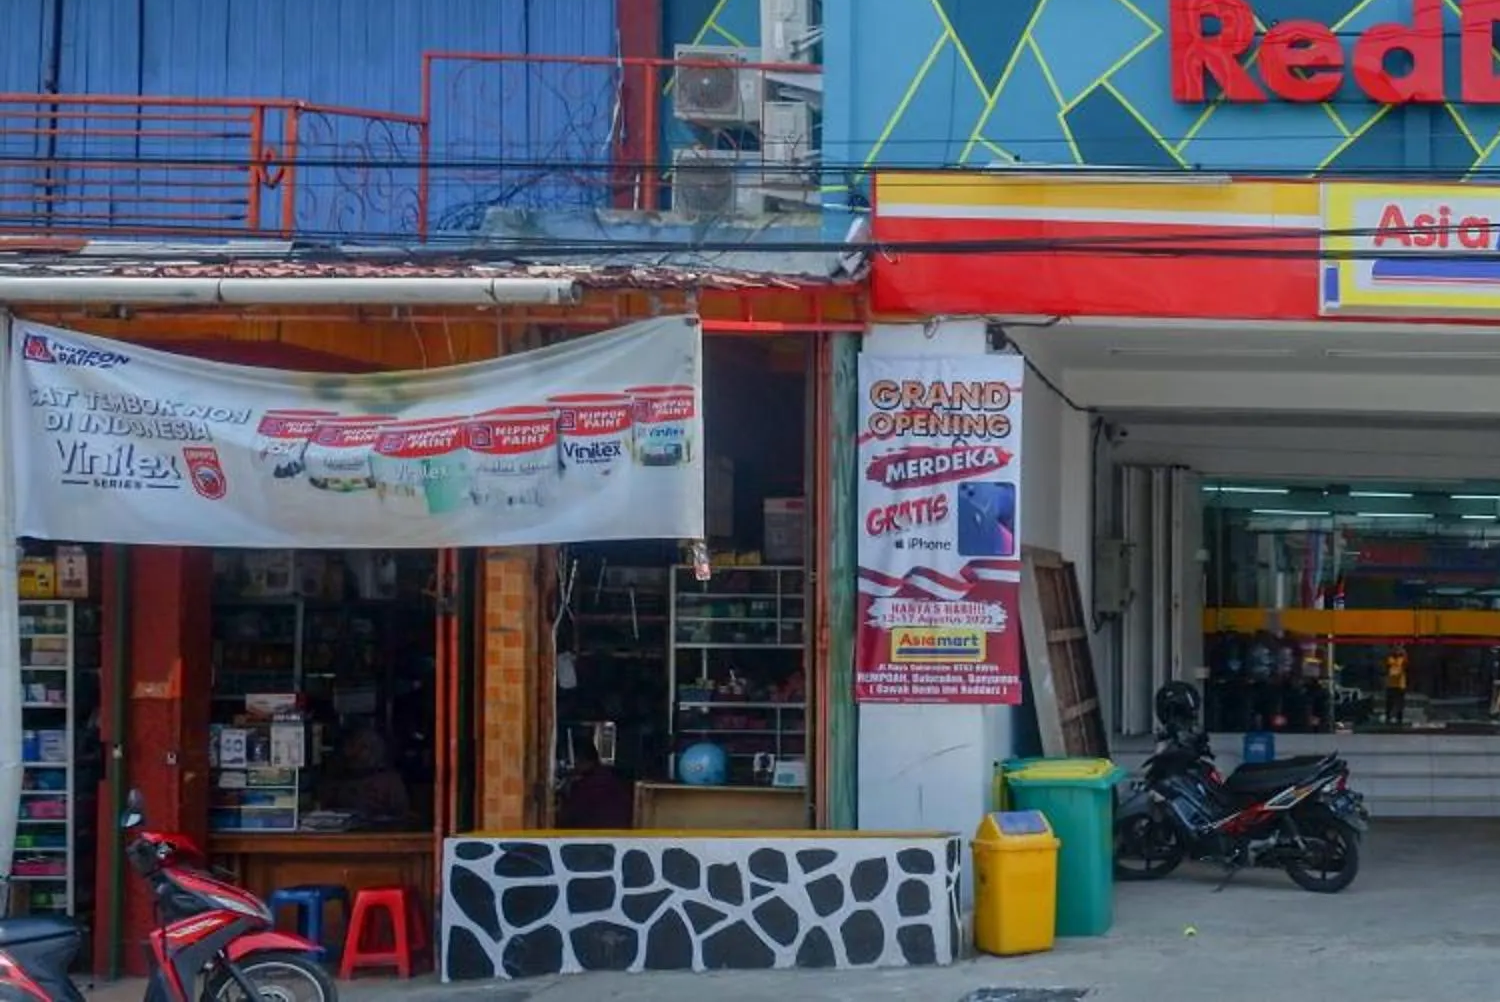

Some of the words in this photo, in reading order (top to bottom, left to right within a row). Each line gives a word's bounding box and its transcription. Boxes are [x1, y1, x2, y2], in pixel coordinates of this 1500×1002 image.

[31, 387, 80, 407] AT
[870, 379, 1011, 411] GRAND
[578, 408, 627, 420] NIPPON
[45, 412, 74, 432] DI
[78, 412, 213, 443] INDONESIA
[495, 423, 551, 436] NIPPON
[584, 417, 622, 429] PAINT
[868, 412, 1011, 439] OPENING
[502, 433, 545, 446] PAINT
[563, 439, 622, 459] Vinilex
[56, 438, 182, 481] Vinilex
[885, 447, 999, 483] MERDEKA
[92, 478, 142, 490] SERIES
[866, 493, 949, 536] GRATIS
[907, 537, 952, 550] iPhone
[917, 613, 962, 626] Agustus
[899, 632, 980, 647] Asiamart
